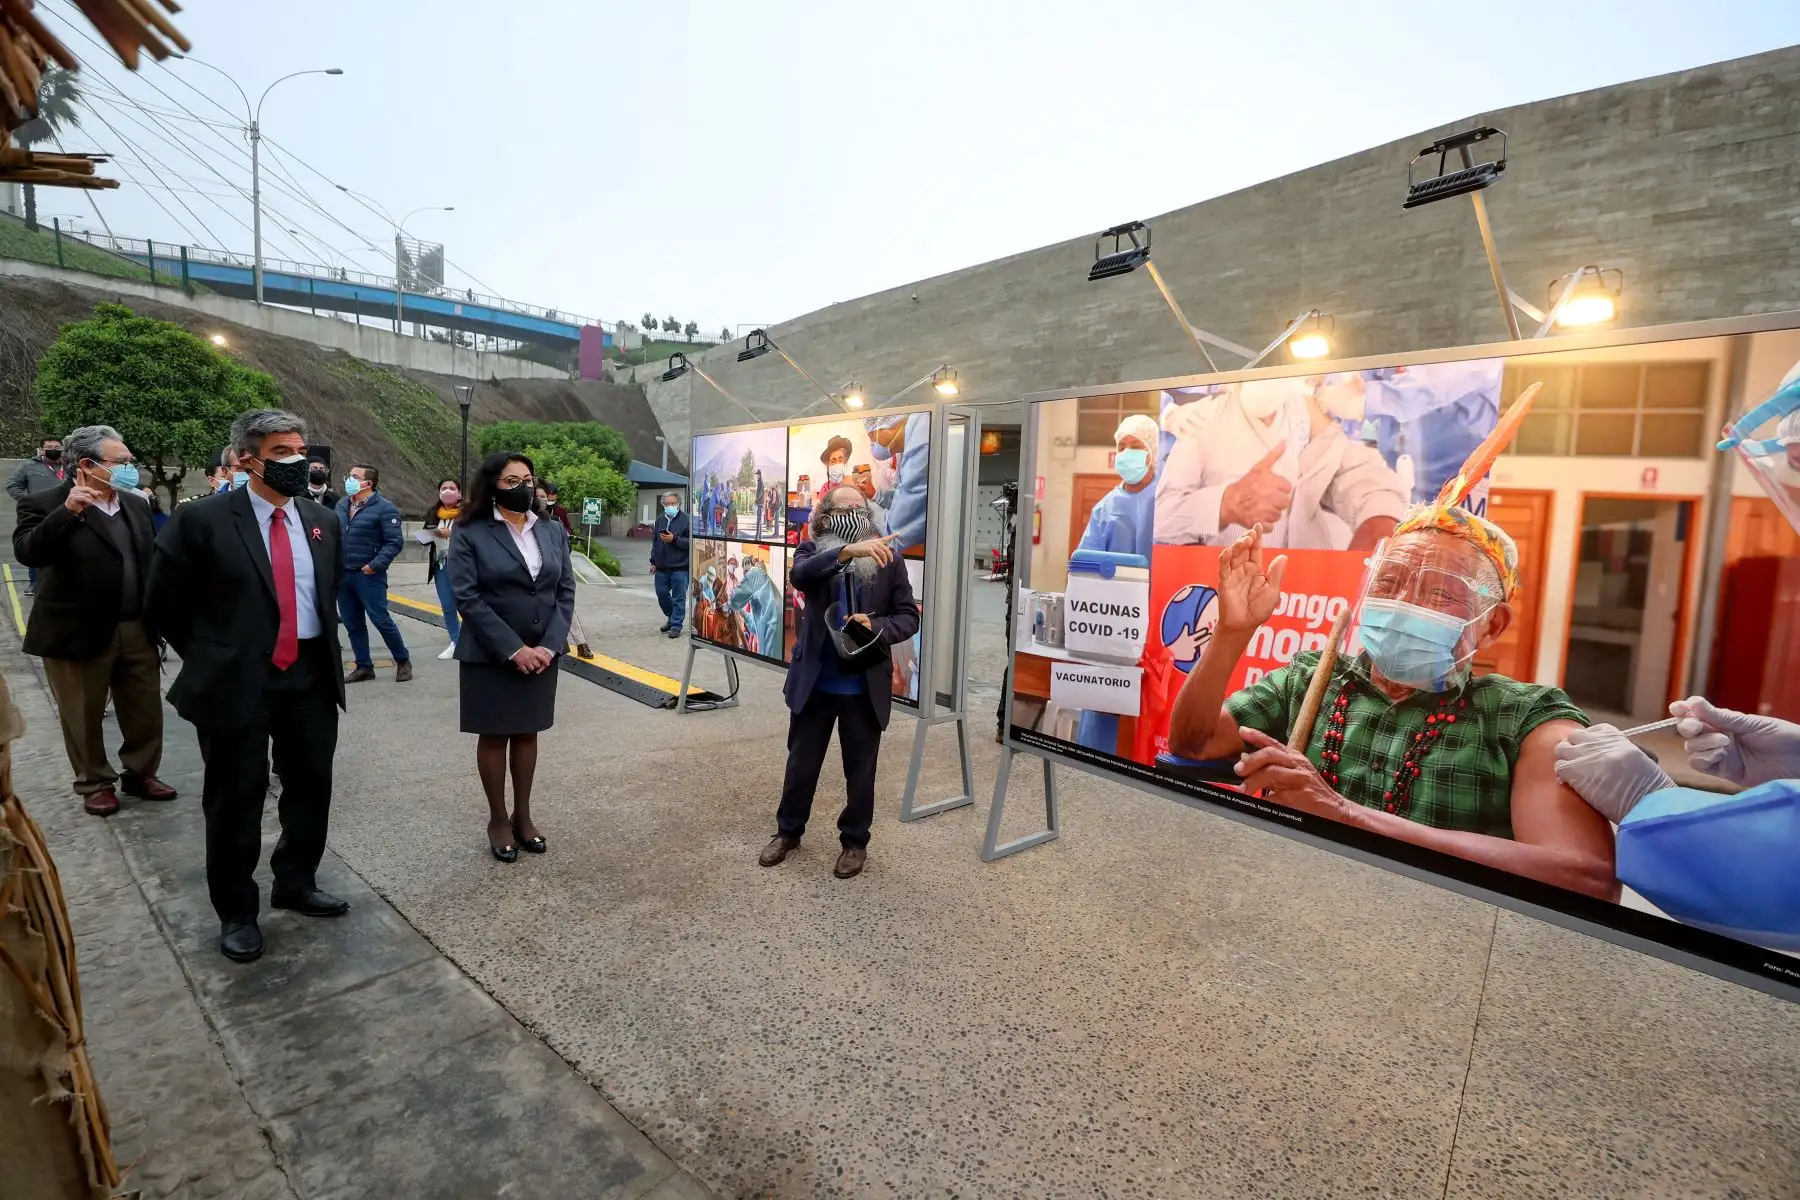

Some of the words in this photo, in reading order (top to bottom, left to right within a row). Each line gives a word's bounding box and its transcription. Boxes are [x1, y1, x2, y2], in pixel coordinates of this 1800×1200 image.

[1070, 599, 1141, 619] VACUNAS
[1272, 591, 1348, 629] ongo
[1068, 620, 1113, 637] COVID
[1117, 627, 1140, 640] -19
[1055, 671, 1131, 688] VACUNATORIO
